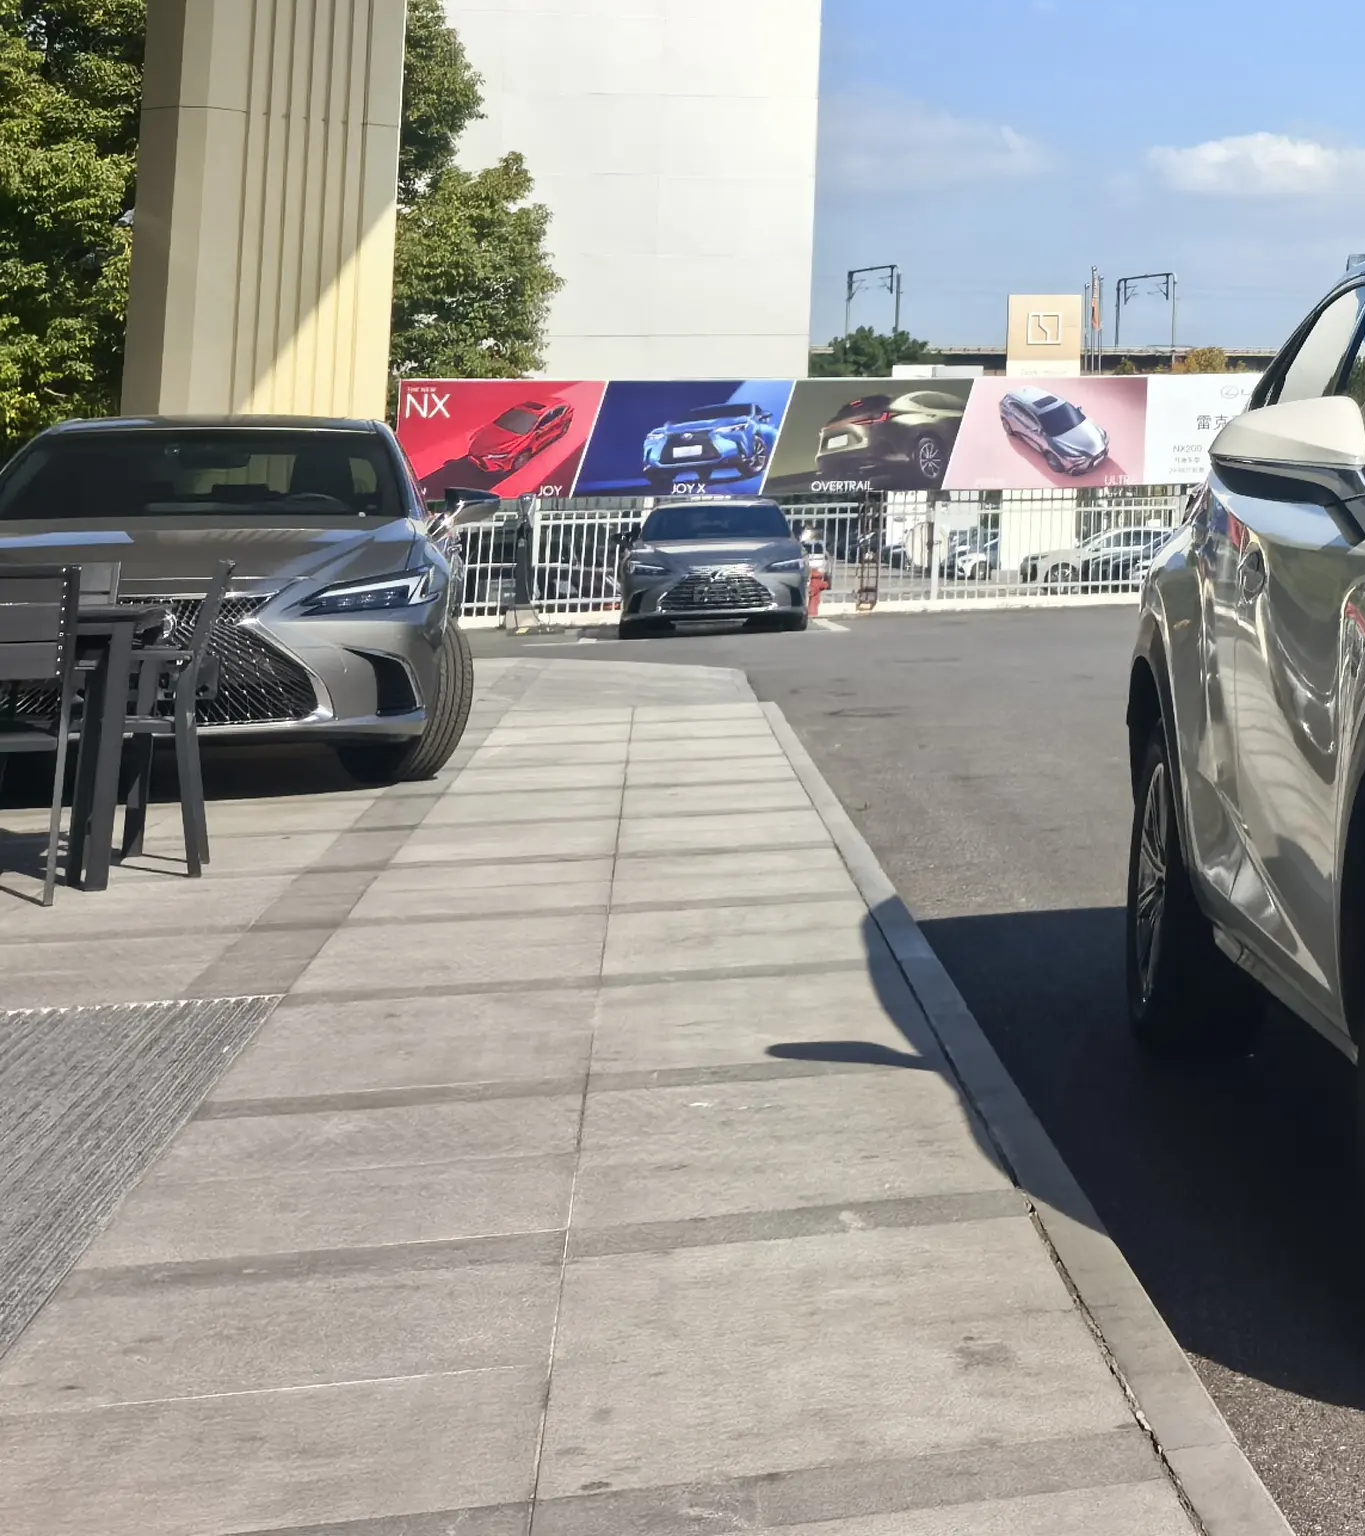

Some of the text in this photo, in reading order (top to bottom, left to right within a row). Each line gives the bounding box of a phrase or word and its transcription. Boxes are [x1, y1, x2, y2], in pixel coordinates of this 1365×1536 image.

[405, 393, 451, 419] NX
[538, 485, 563, 496] JOY
[671, 483, 707, 495] JOY X
[811, 480, 874, 492] OVERTRAIL
